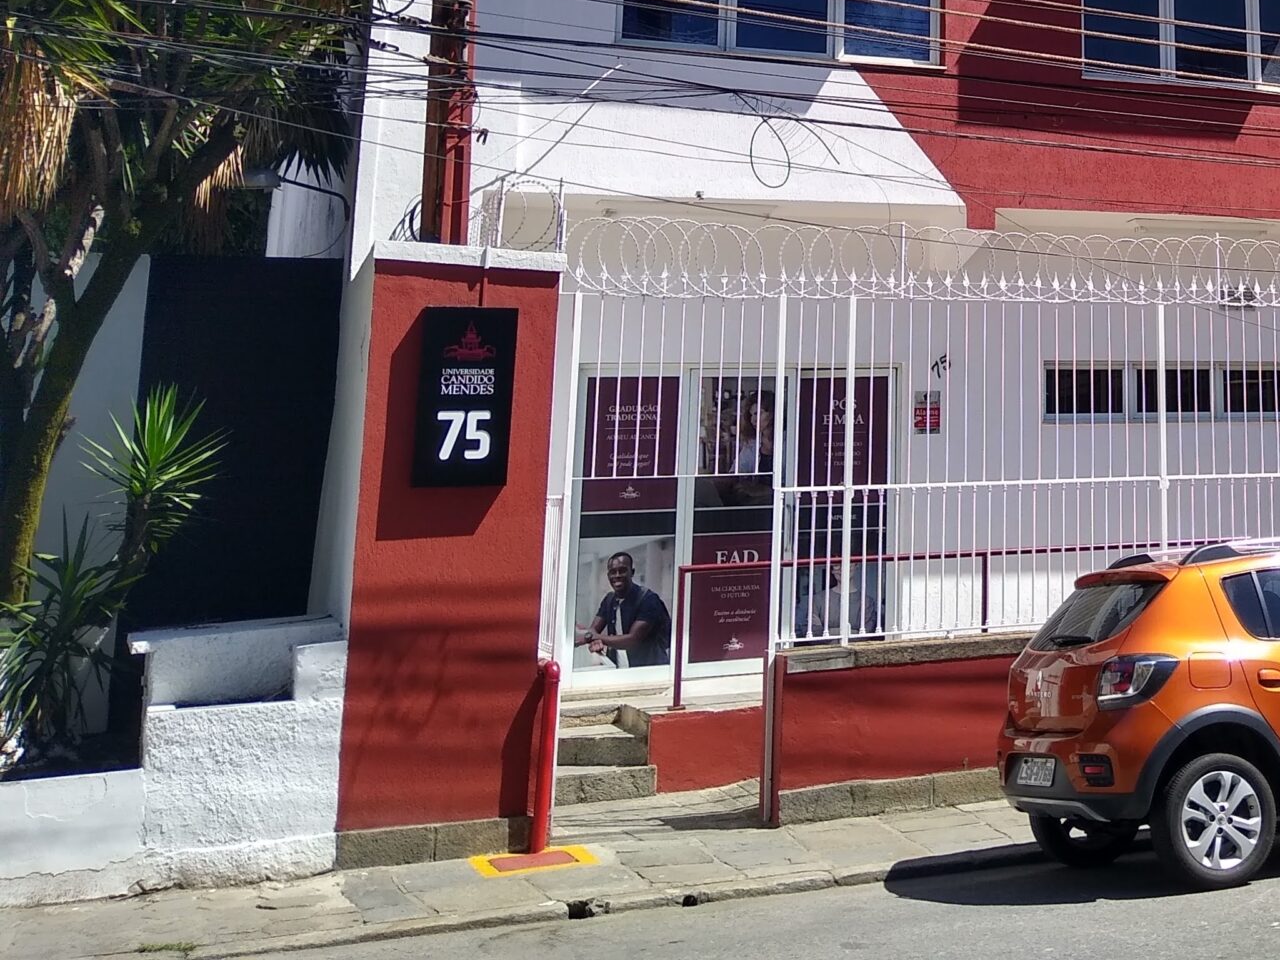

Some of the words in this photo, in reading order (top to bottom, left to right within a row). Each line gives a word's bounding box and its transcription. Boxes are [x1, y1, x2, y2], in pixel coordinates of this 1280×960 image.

[441, 375, 495, 384] CANDIDO
[440, 384, 494, 395] MENDES
[605, 413, 662, 422] TRADICONA
[834, 413, 864, 425] MA
[437, 410, 491, 460] 75
[715, 549, 759, 565] EAD
